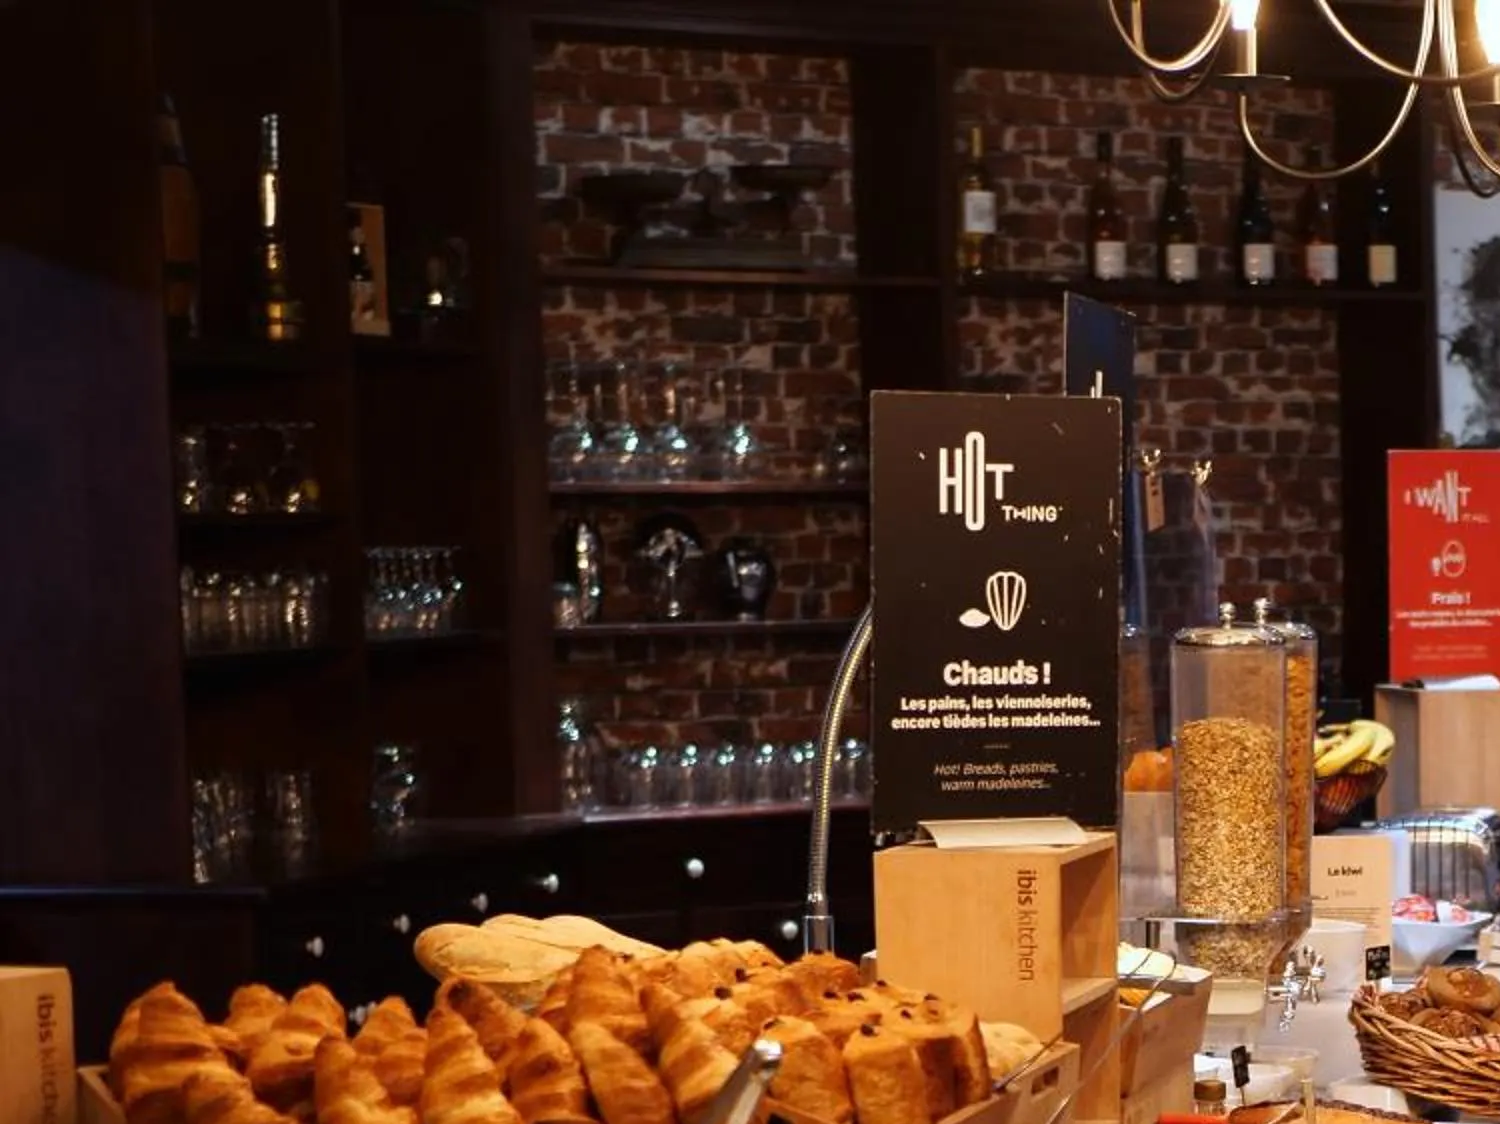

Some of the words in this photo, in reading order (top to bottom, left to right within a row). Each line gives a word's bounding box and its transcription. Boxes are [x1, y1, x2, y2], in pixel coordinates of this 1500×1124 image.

[939, 431, 1015, 531] HOT
[1001, 505, 1060, 523] THING
[943, 660, 1039, 686] Chauds
[1042, 661, 1052, 685] !
[900, 697, 926, 710] Les
[928, 696, 970, 713] pains,
[972, 695, 994, 710] les
[996, 694, 1092, 711] viennoiseries,
[891, 716, 941, 730] encore
[943, 714, 987, 729] tièdes
[988, 713, 1009, 728] les
[941, 780, 975, 792] warm
[1327, 867, 1341, 877] Le
[1341, 865, 1363, 877] kiwi
[1017, 869, 1038, 907] ibis
[1018, 909, 1039, 981] kitchen
[37, 993, 57, 1043] ibis
